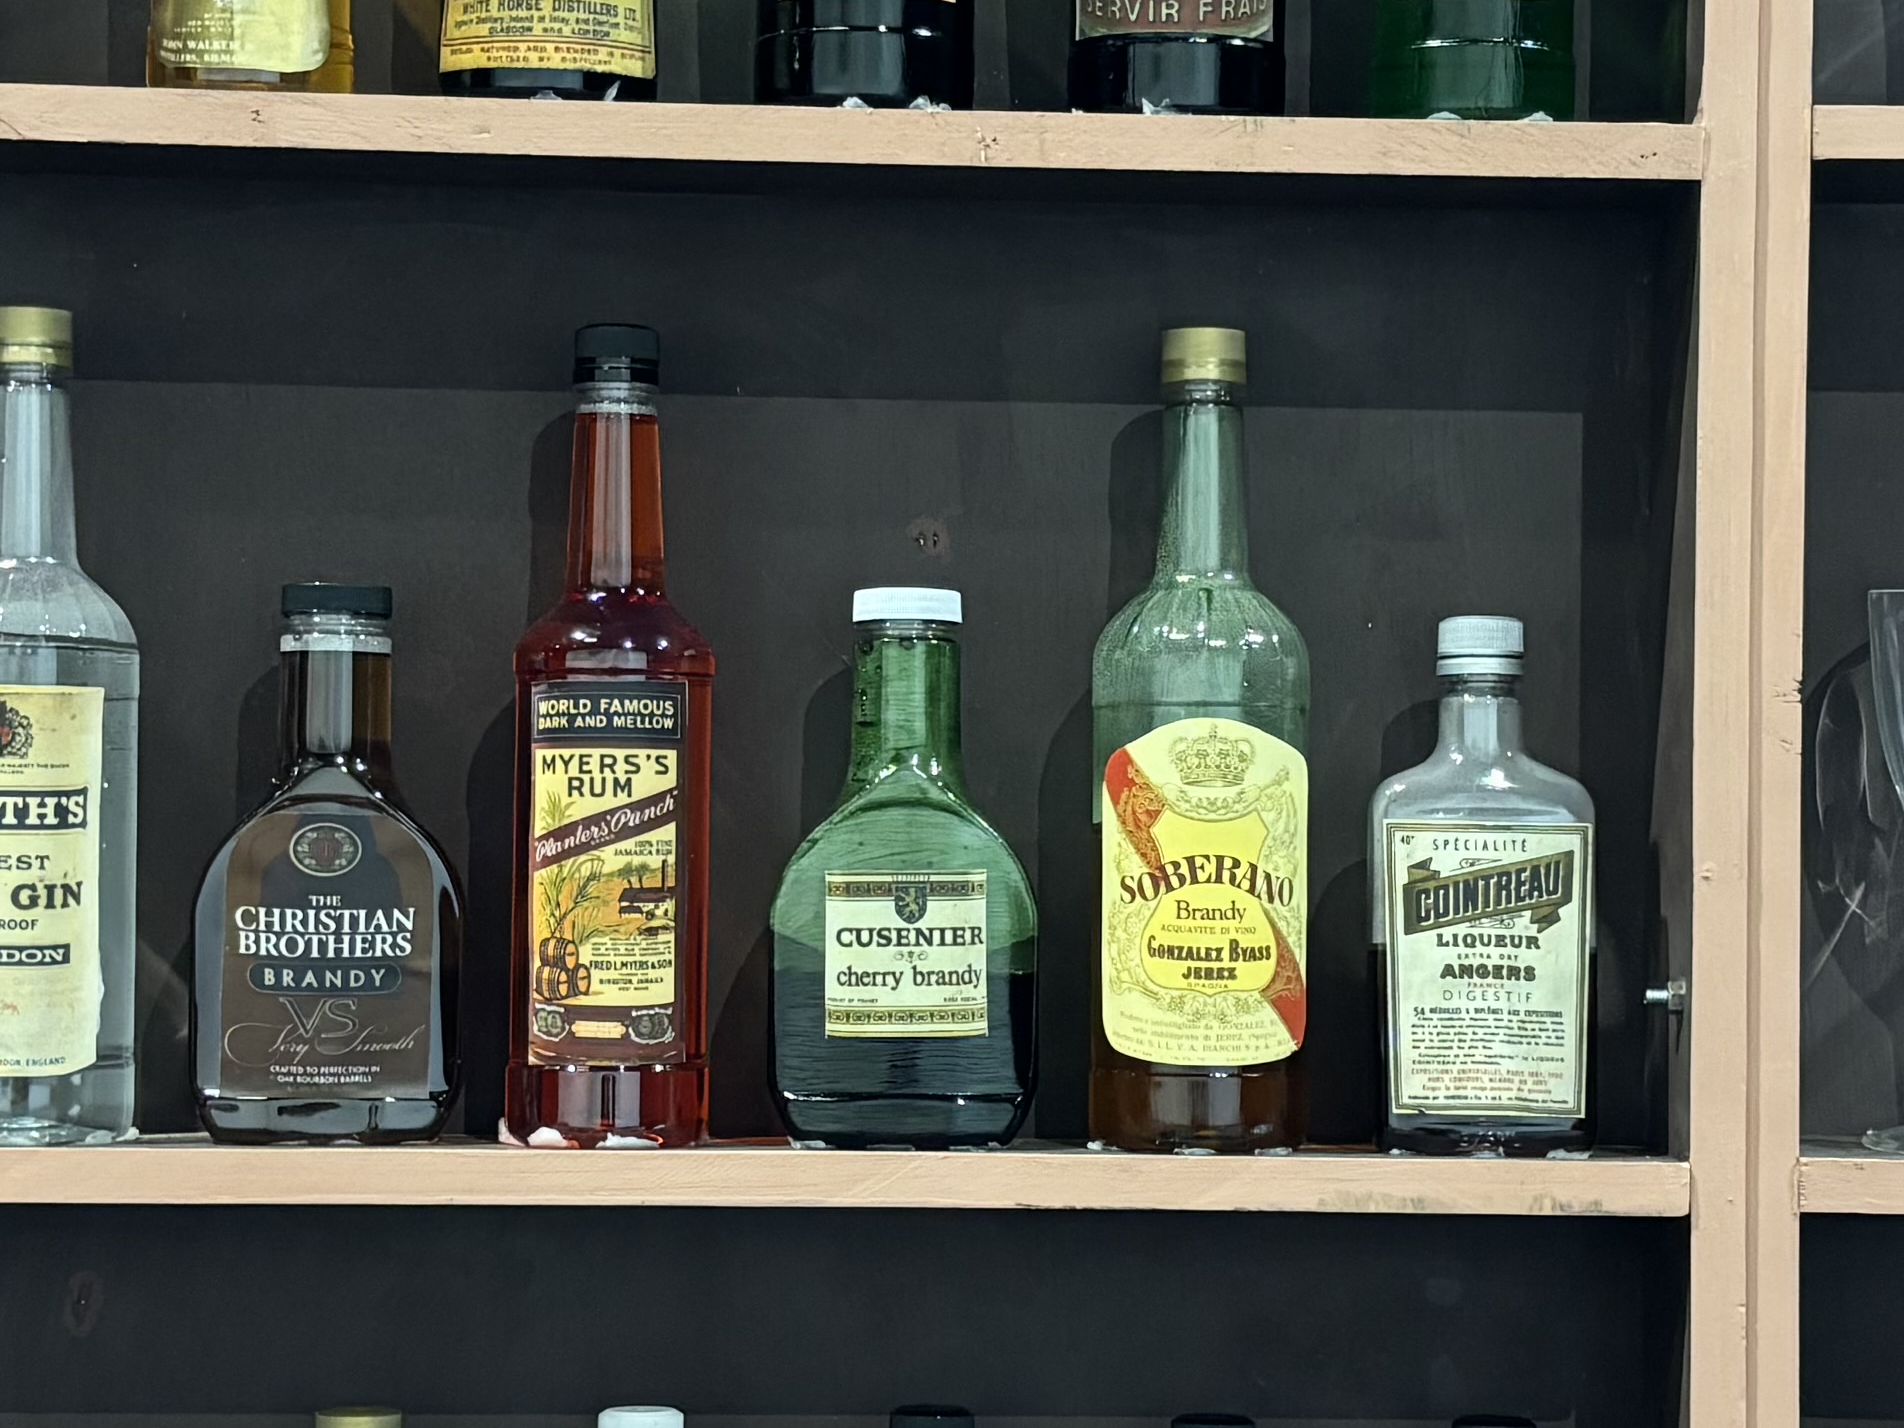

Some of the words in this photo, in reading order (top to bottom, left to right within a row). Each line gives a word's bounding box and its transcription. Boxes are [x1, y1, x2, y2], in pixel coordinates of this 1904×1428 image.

[538, 697, 592, 716] WORLD
[599, 696, 674, 715] FAMOUS
[538, 715, 569, 730] DARK
[574, 714, 608, 728] AND
[613, 714, 675, 730] MELLOW
[541, 753, 671, 776] MYERS'S
[566, 776, 634, 800] RUM
[1119, 853, 1294, 908] SOBERANO
[10, 880, 84, 910] GIN
[309, 895, 342, 907] THE
[1415, 859, 1562, 927] COINTREAU
[234, 906, 416, 934] CHRISTIAN
[1176, 899, 1247, 925] Brandy
[238, 932, 413, 958] BROTHERS
[836, 926, 984, 948] CUSENIER
[1436, 932, 1541, 950] LIQUEUR
[1147, 935, 1224, 963] GONZALEZ
[1228, 938, 1272, 963] BYASS
[264, 968, 386, 989] BRANDY
[836, 964, 903, 991] cherry
[911, 963, 982, 988] brandy
[1181, 966, 1238, 981] JEREZ
[1439, 964, 1536, 982] ANGERS
[1442, 989, 1533, 1004] DIGESTIF
[279, 997, 359, 1038] VS
